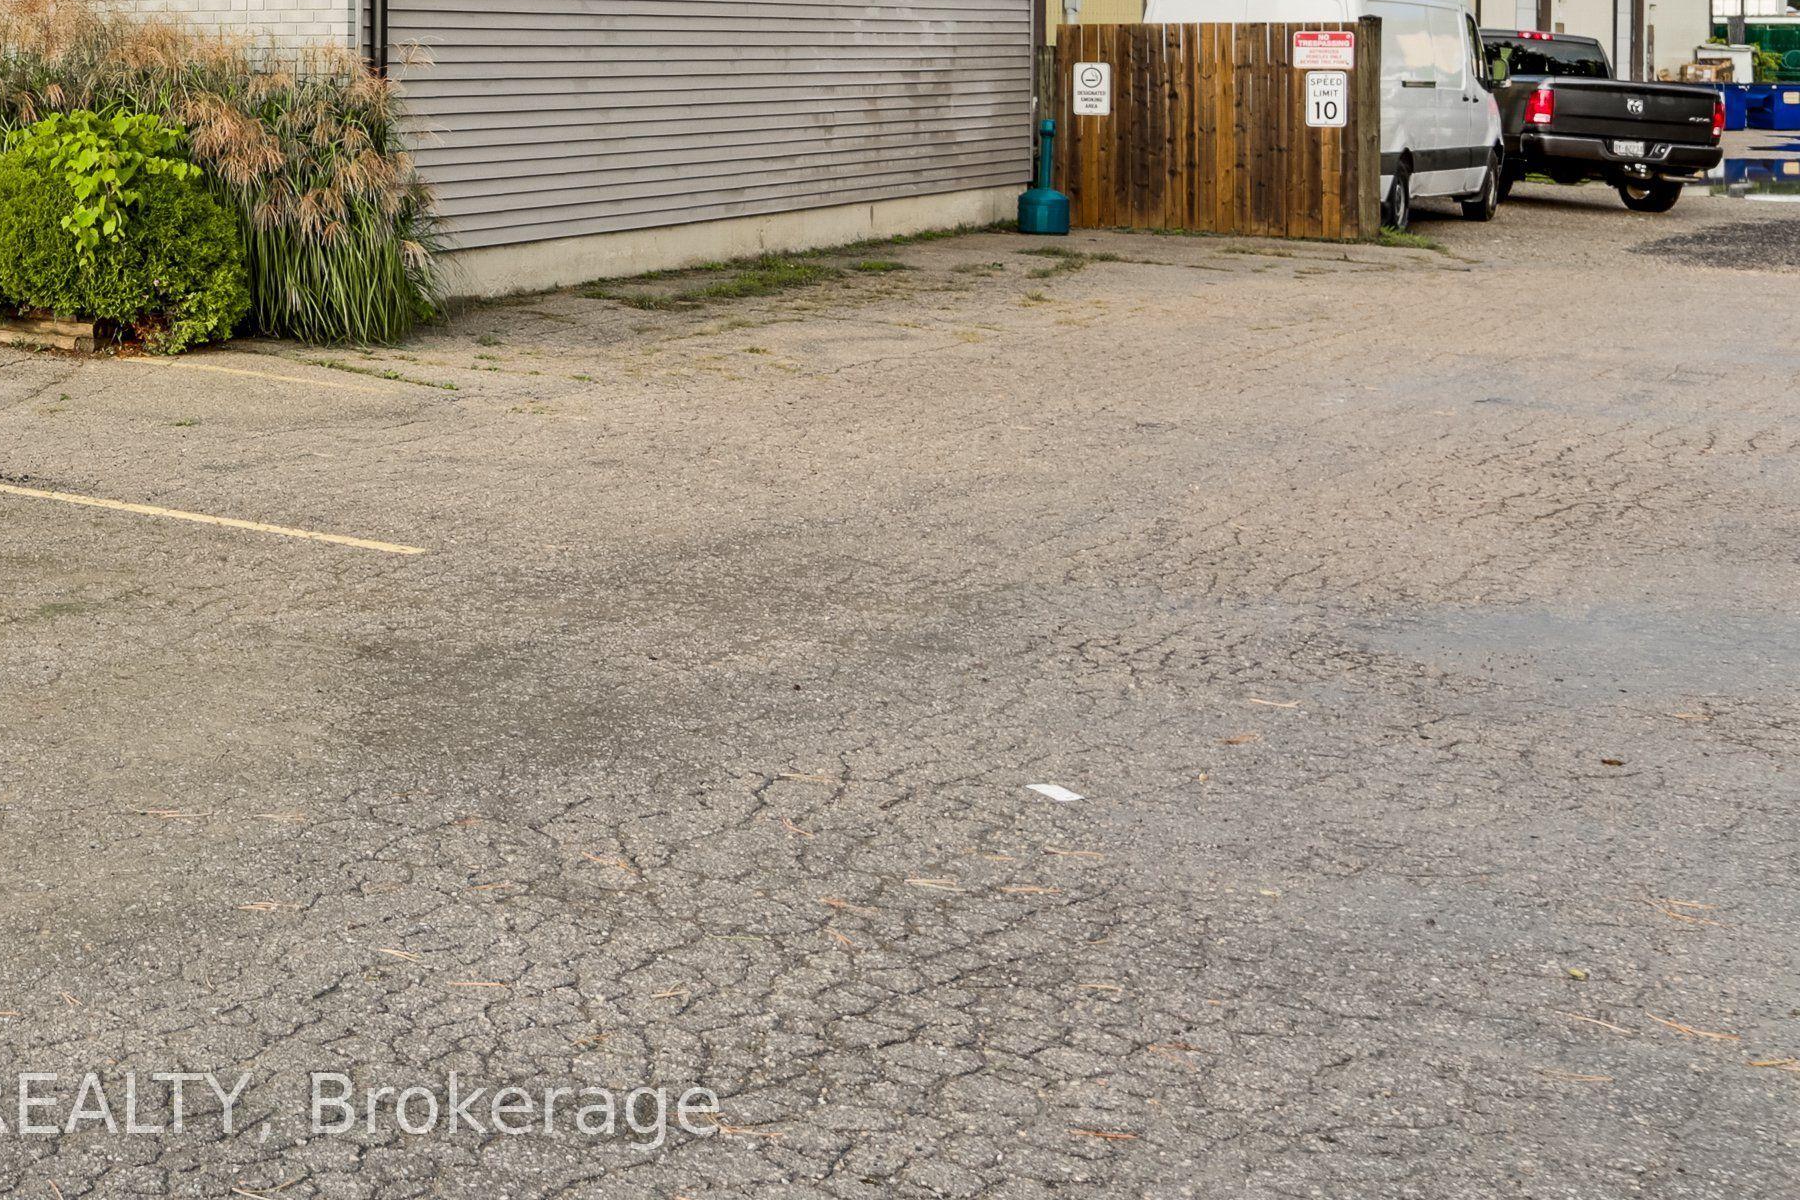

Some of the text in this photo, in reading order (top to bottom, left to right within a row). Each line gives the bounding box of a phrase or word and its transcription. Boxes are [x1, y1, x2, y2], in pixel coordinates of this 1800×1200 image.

[1317, 33, 1330, 41] NO
[1298, 39, 1350, 47] TRESPASSING
[1310, 78, 1342, 86] SPEED
[1315, 101, 1337, 119] 10
